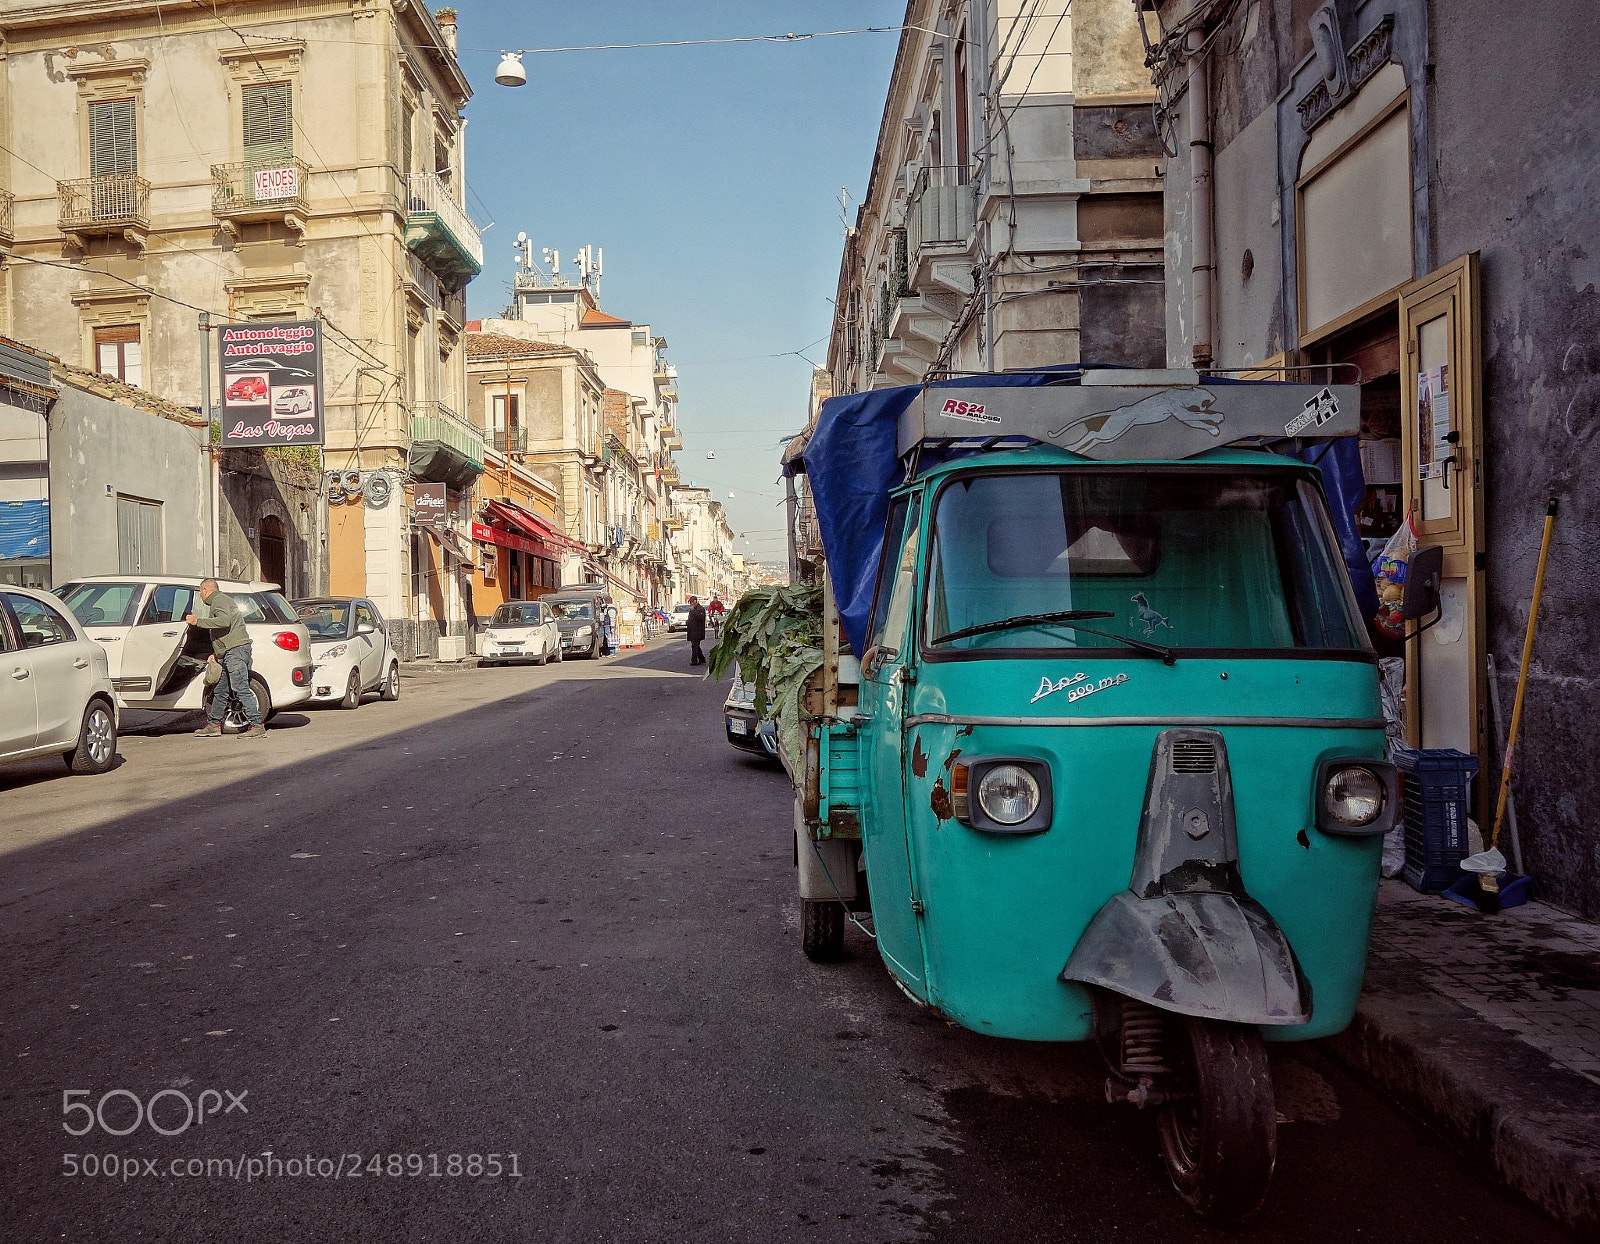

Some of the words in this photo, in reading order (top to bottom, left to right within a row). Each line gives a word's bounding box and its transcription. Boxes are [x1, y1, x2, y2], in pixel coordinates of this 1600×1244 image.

[256, 169, 297, 188] VENDESI
[223, 326, 314, 341] Autonoleggio
[224, 341, 315, 356] Autolavaggio
[228, 421, 263, 438] Las
[264, 420, 314, 441] Vegas
[1031, 673, 1089, 702] Ape
[1068, 683, 1095, 702] 600
